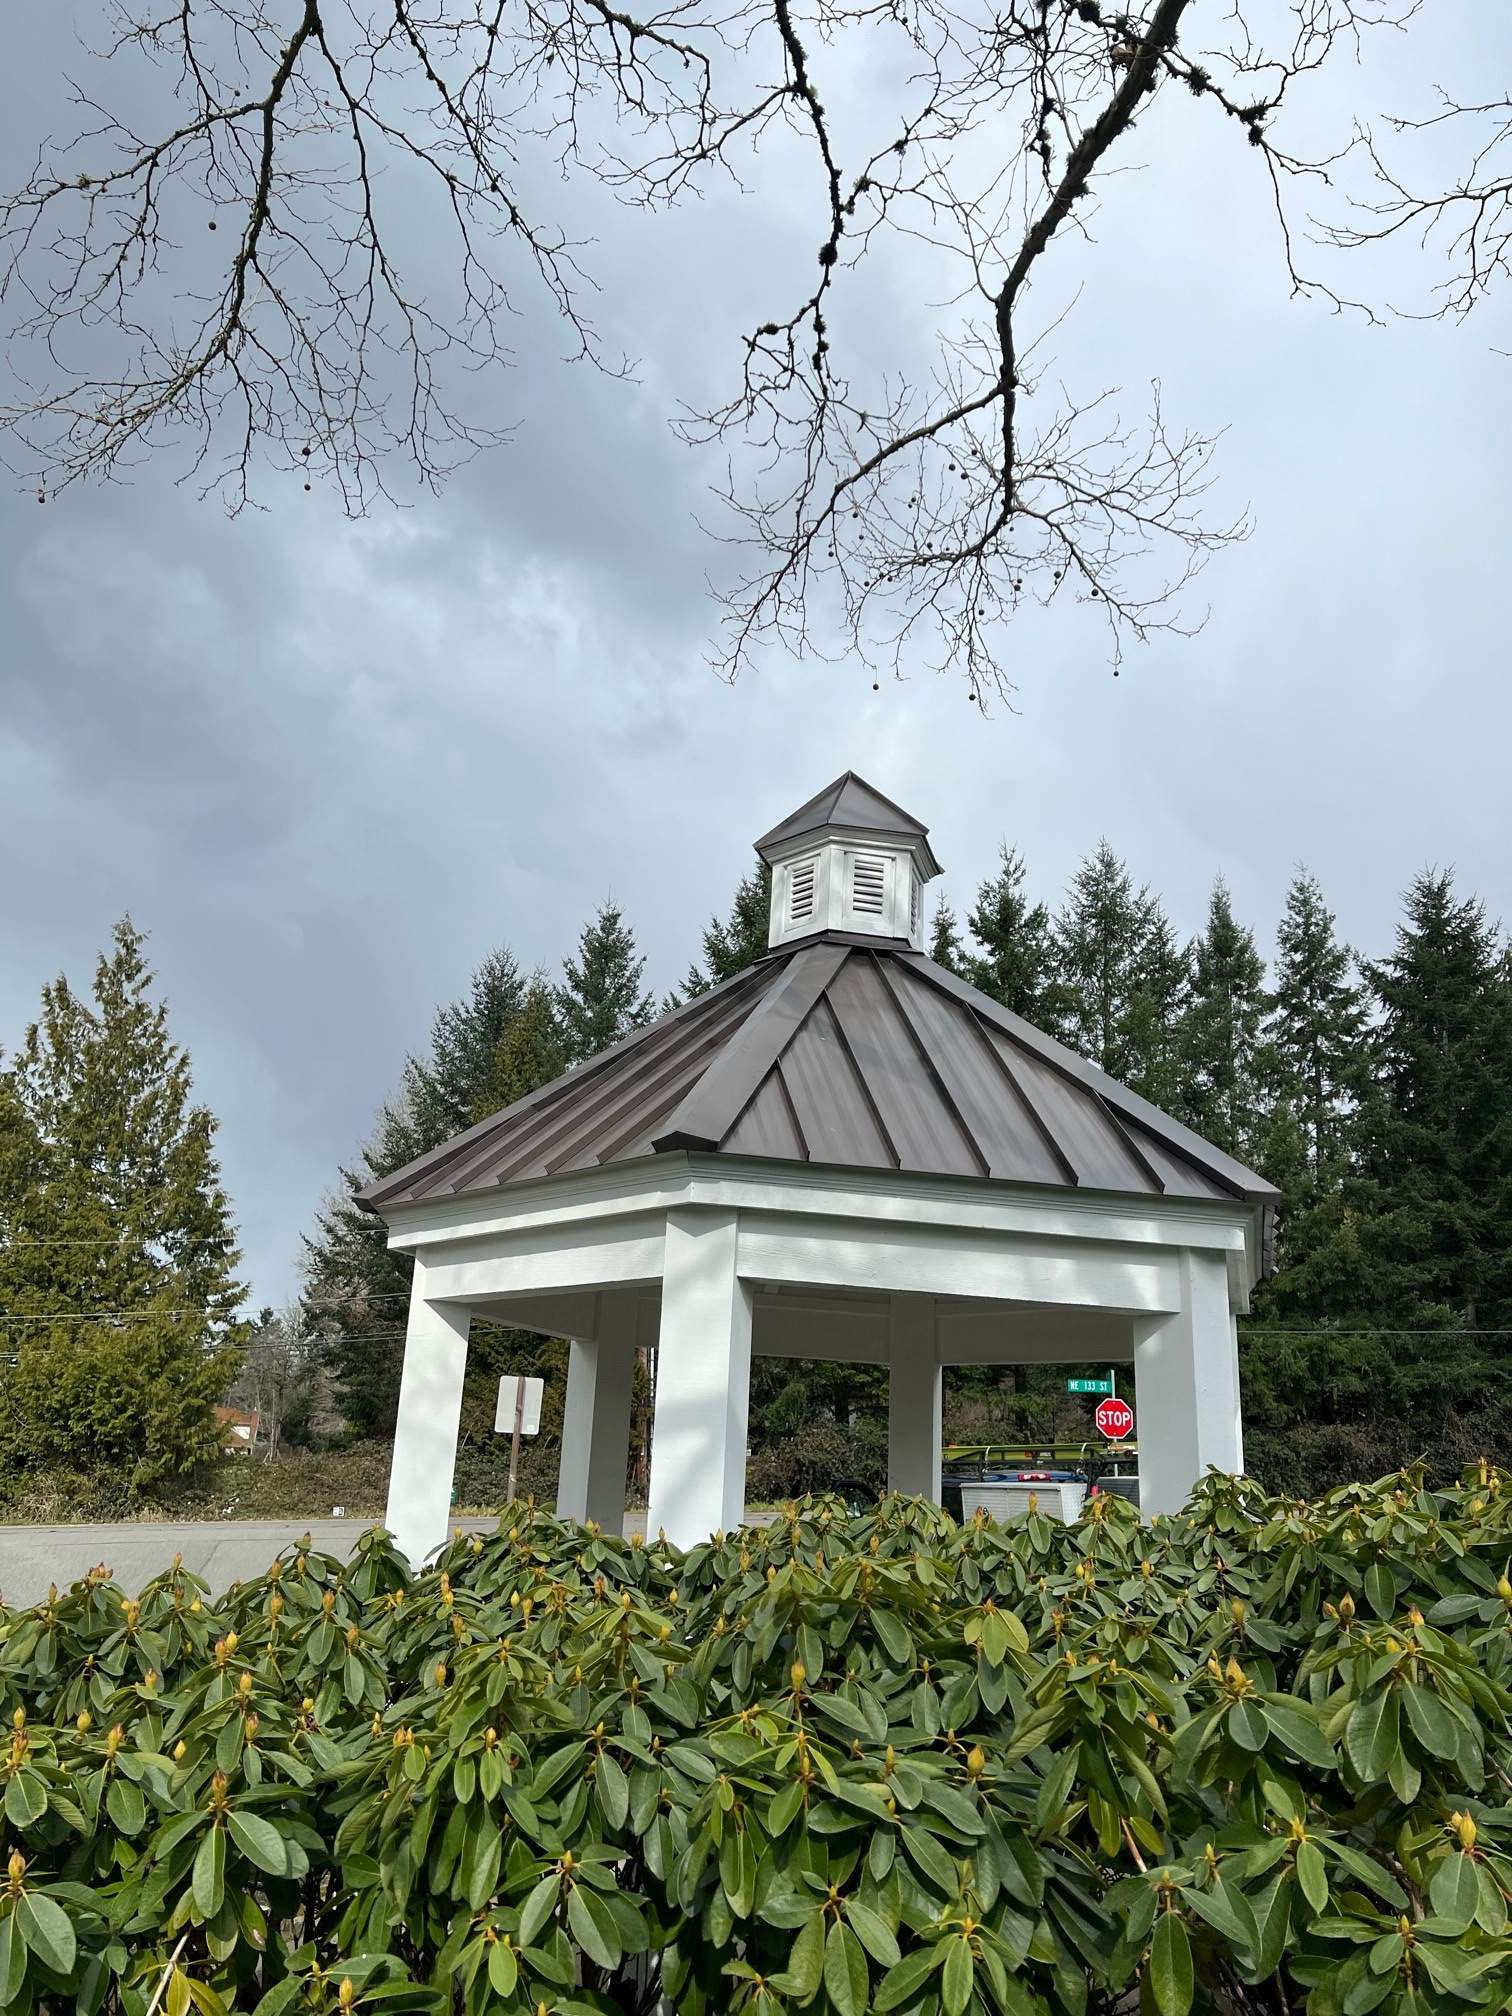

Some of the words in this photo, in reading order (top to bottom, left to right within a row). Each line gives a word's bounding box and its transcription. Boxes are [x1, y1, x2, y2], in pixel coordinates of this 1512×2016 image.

[1070, 1380, 1079, 1390] NE
[1084, 1381, 1096, 1390] 133
[1099, 1382, 1107, 1391] ST
[1098, 1411, 1130, 1426] STOP
